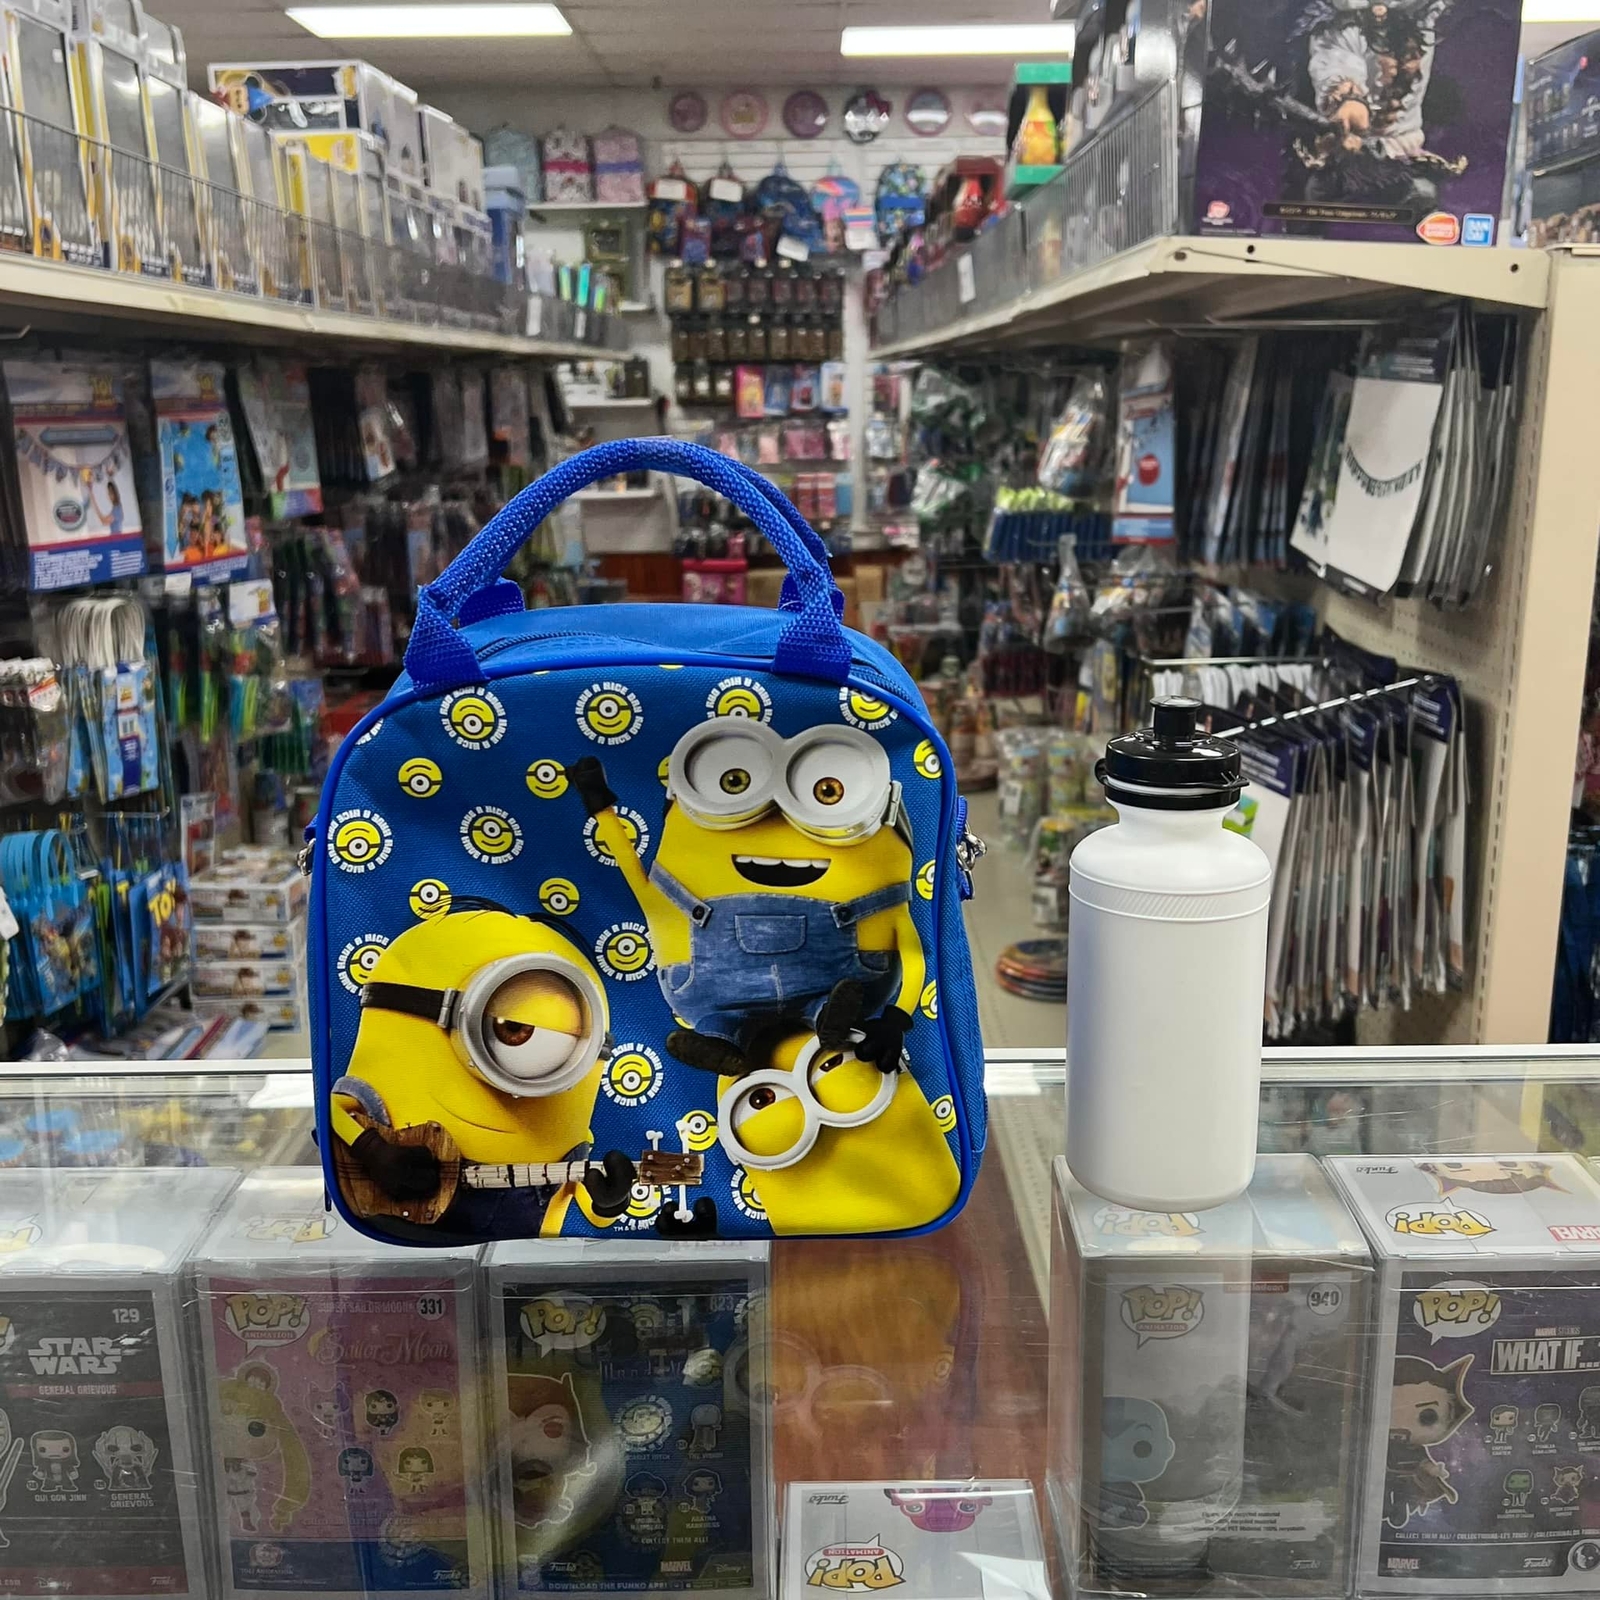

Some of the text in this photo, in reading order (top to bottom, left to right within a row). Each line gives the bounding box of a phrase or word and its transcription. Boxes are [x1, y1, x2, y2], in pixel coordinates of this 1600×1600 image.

[1356, 1166, 1398, 1174] Funko
[1394, 1211, 1498, 1236] POP!
[420, 1298, 442, 1314] 331
[1120, 1285, 1204, 1323] POP!
[1310, 1291, 1340, 1307] 940
[1415, 1289, 1500, 1327] POP!
[112, 1308, 140, 1324] 129
[225, 1293, 306, 1331] POP!
[520, 1299, 604, 1338] POP!
[28, 1337, 121, 1356] STAR
[1497, 1340, 1562, 1371] WHAT
[29, 1356, 122, 1375] WARS
[38, 1384, 117, 1394] GENERAL GRIEVOUS
[110, 1500, 154, 1508] GRIEVOUS
[808, 1494, 849, 1505] Funko
[806, 1555, 906, 1589] POP!
